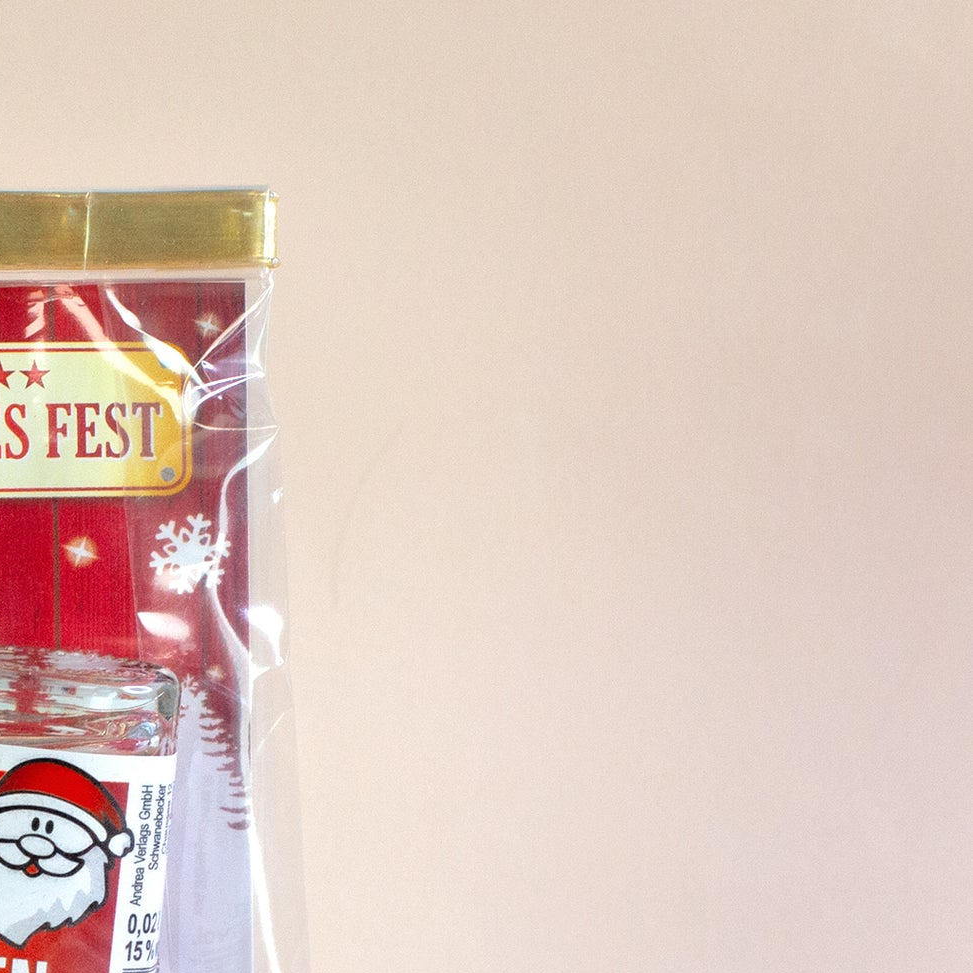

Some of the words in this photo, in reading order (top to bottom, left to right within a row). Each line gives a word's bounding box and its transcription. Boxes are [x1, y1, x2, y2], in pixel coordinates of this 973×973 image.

[45, 402, 164, 462] FEST
[139, 784, 154, 823] GmbH
[134, 824, 152, 865] Verlags
[148, 783, 167, 871] Schwanebecker
[129, 867, 145, 907] Andrea
